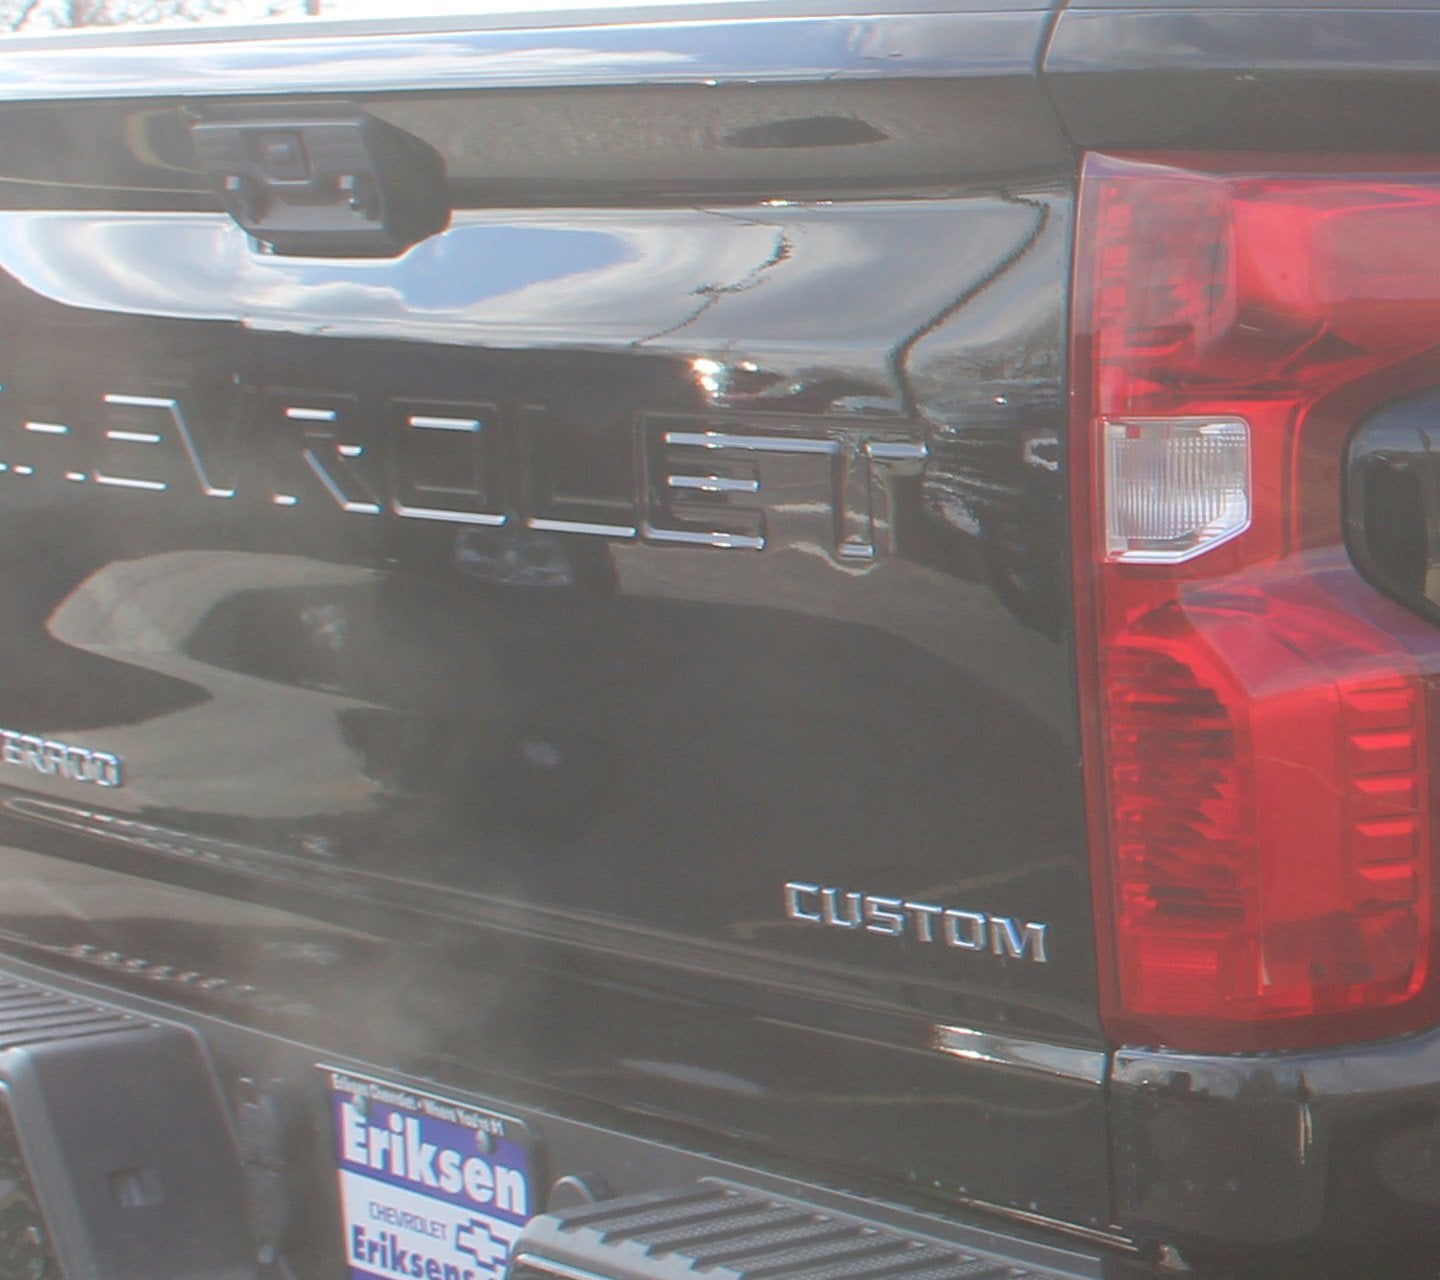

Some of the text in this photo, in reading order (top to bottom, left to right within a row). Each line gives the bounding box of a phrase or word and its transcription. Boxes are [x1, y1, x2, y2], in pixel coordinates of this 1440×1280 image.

[0, 728, 123, 788] ERADO
[785, 880, 1049, 964] CUSTOM
[341, 1101, 528, 1216] Eriksen
[368, 1201, 448, 1241] CHEVROLET
